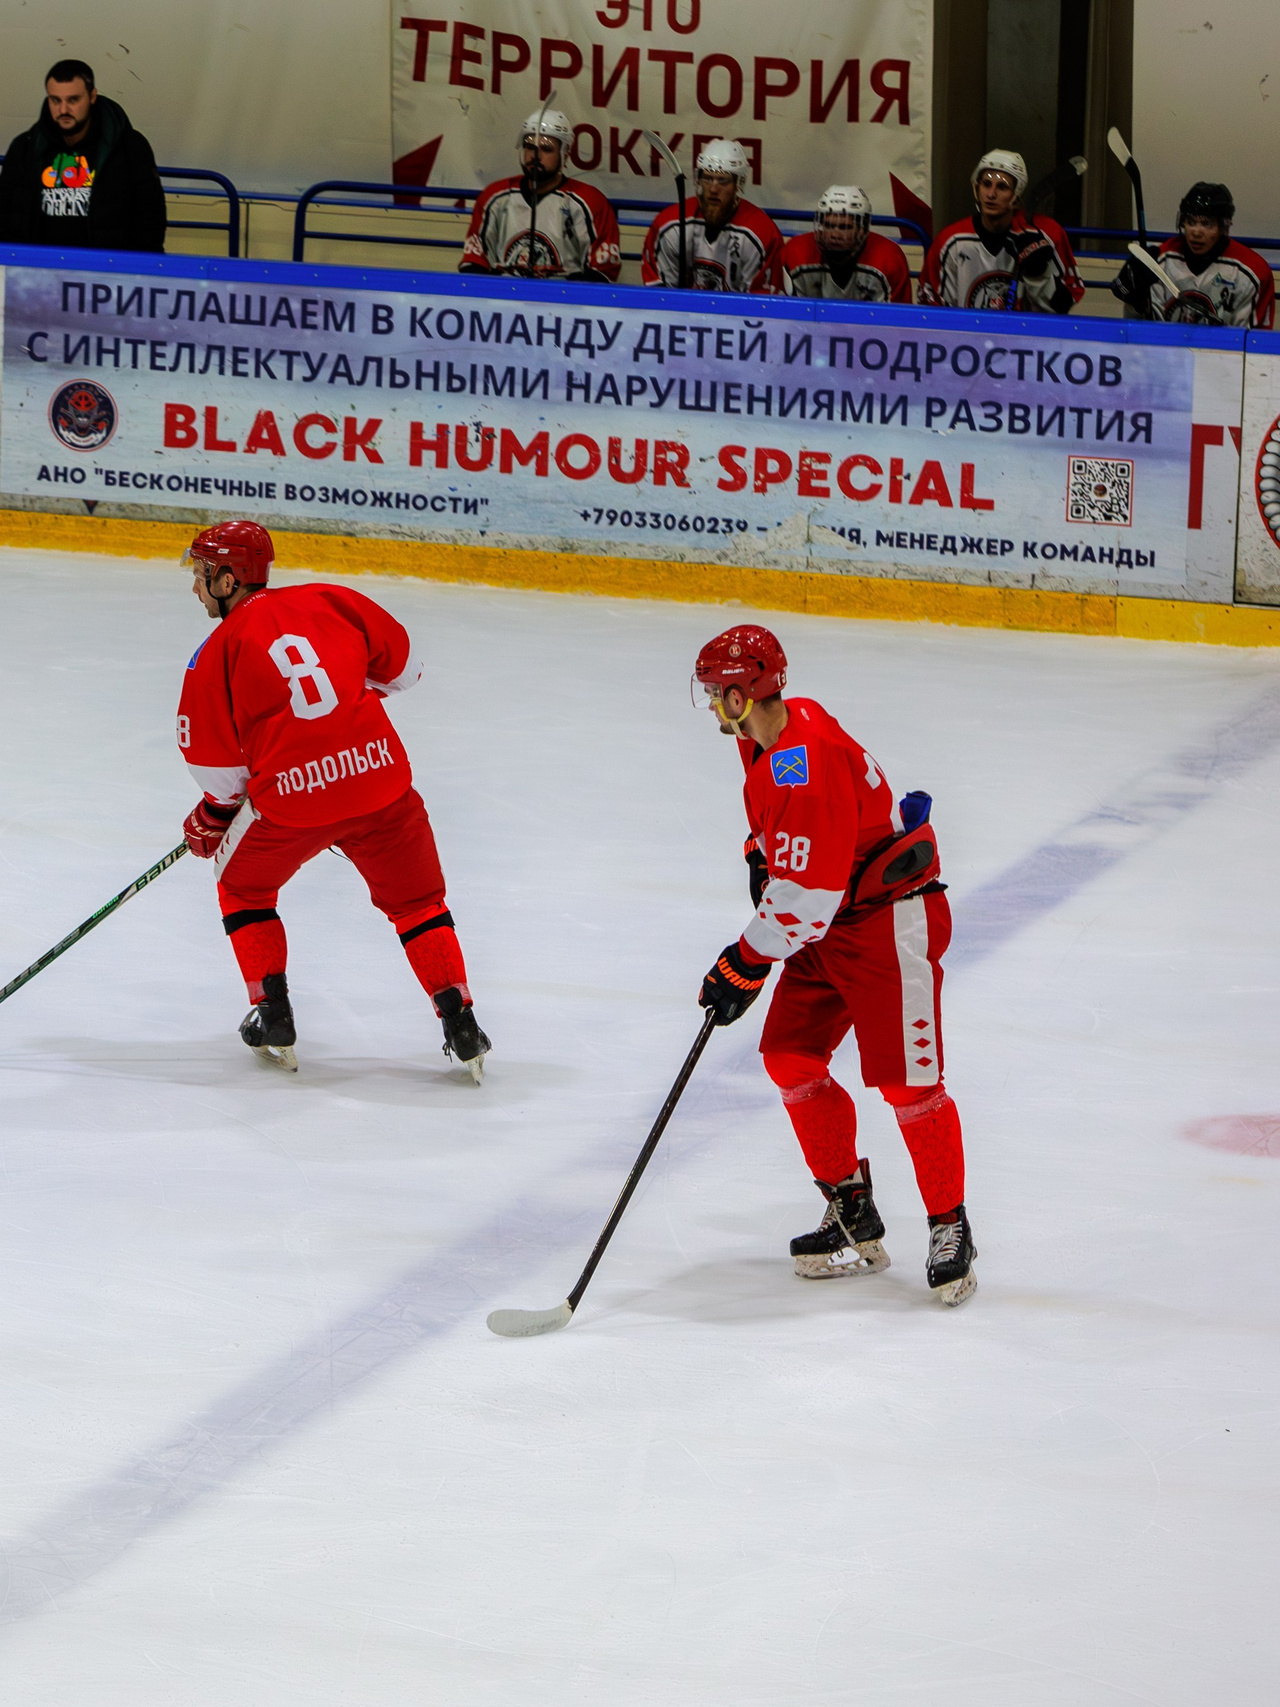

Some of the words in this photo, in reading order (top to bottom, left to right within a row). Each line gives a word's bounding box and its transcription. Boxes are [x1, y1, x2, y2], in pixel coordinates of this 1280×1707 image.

[400, 16, 911, 126] ТЕРРИТОРИЯ
[61, 282, 356, 333] ПРИГЛАШАЕМ
[372, 305, 395, 335] В
[410, 306, 622, 358] КОМАНДУ
[633, 320, 768, 364] ДЕТЕЙ
[783, 333, 812, 366] И
[829, 337, 1124, 387] ПОДРОСТКОВ
[27, 331, 48, 363] С
[63, 334, 550, 401] ИНТЕЛЛЕКТУАЛЬНЫМИ
[566, 370, 909, 427] НАРУШЕНИЯМИ
[925, 398, 1154, 445] РАЗВИТИЯ
[163, 403, 384, 464] BLACK
[409, 421, 691, 488] HUMOUR
[716, 444, 995, 511] SPECIAL
[36, 465, 87, 485] АНО
[94, 468, 277, 500] "БЕСКОНЕЧНЫЕ
[284, 483, 489, 516] ВОЗМОЖНОСТИ"
[875, 529, 1014, 559] МЕНЕДЖЕР
[1022, 541, 1157, 569] КОМАНДЫ
[268, 633, 339, 721] 8
[721, 667, 746, 676] BAUER
[176, 714, 191, 749] 8
[276, 738, 395, 796] ПОДОЛЬСК
[136, 842, 190, 892] BAUE
[773, 832, 811, 872] 28
